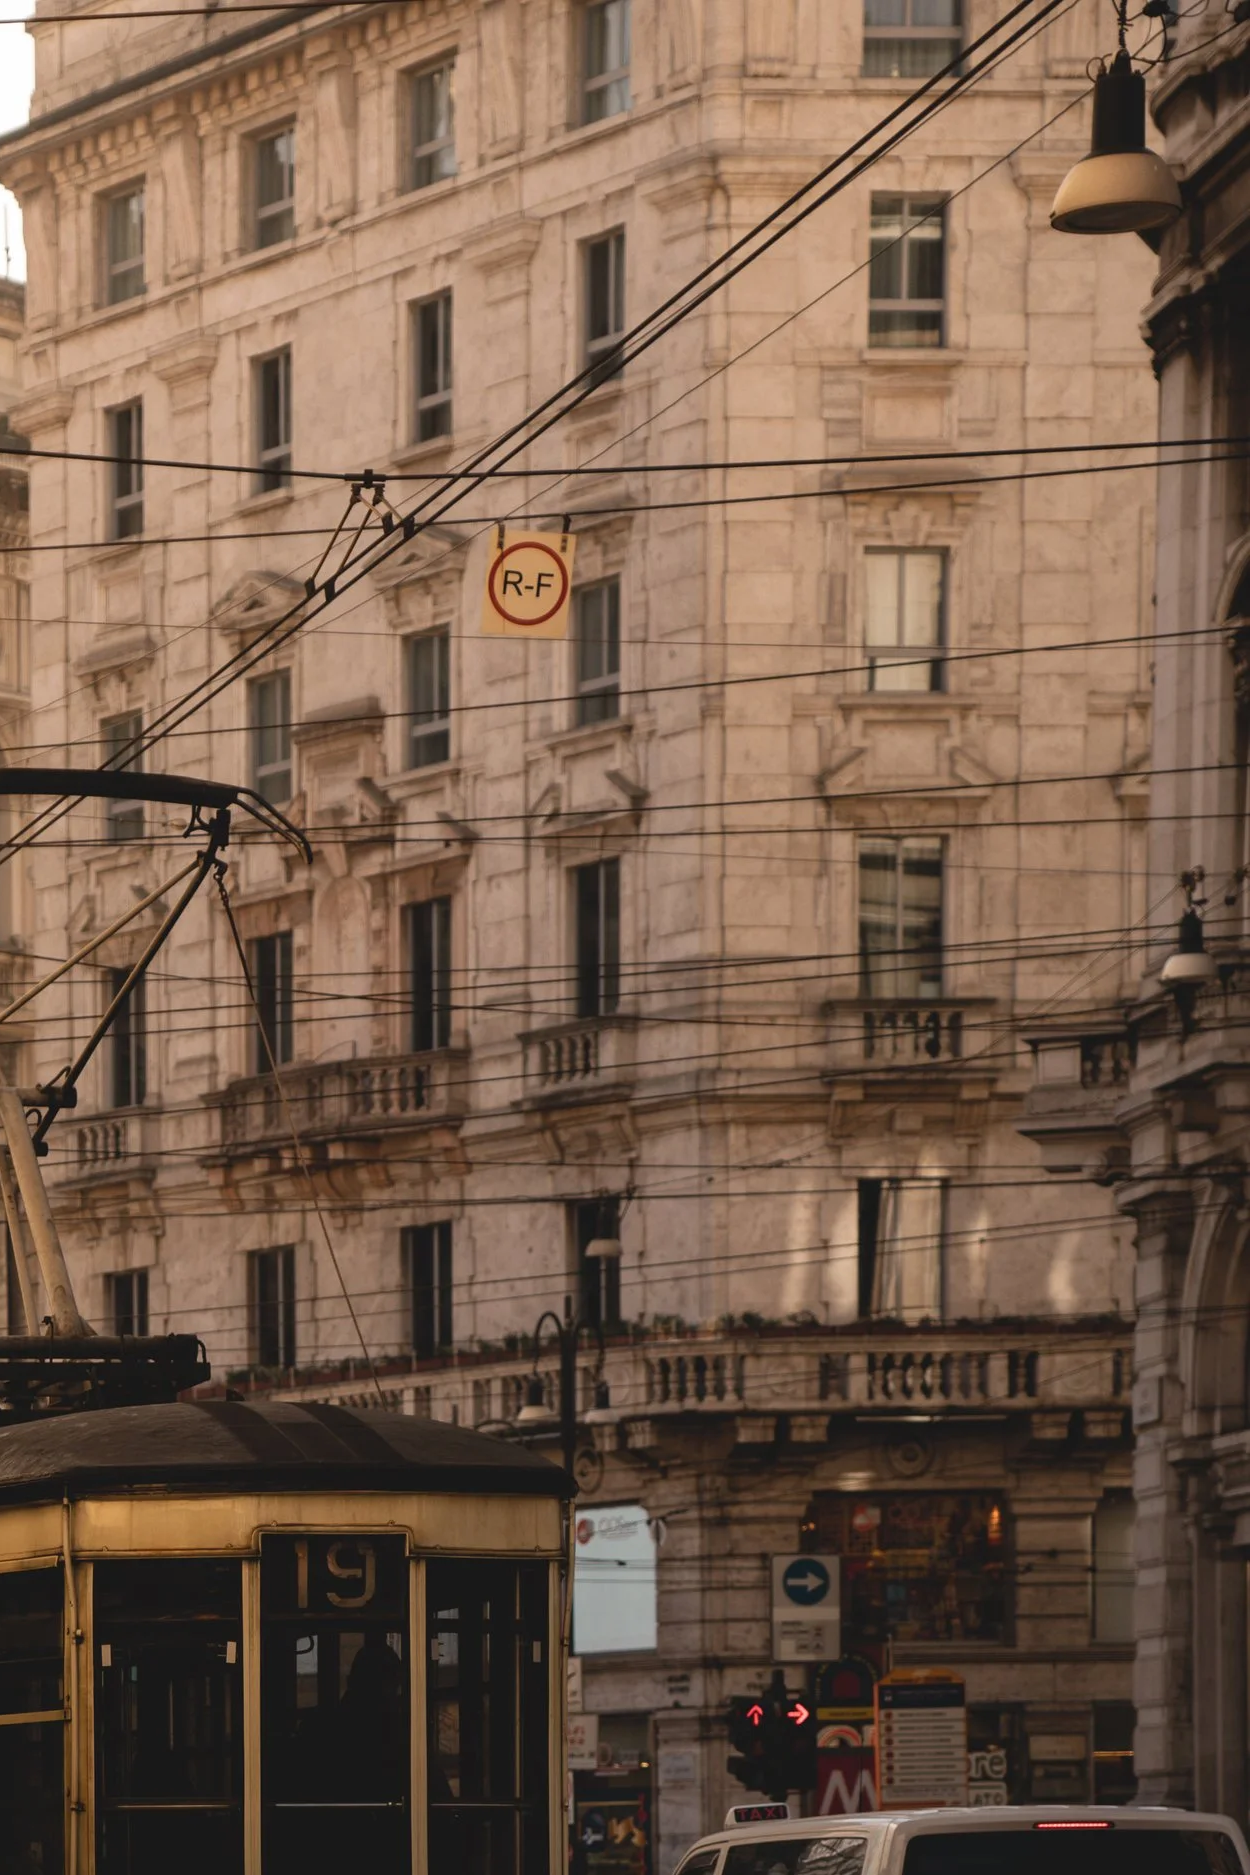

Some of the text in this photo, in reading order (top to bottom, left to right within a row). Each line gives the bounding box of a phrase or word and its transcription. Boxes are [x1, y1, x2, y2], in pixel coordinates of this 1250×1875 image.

[502, 570, 554, 598] R-F
[293, 1539, 378, 1609] 19
[736, 1806, 785, 1821] TAXI
